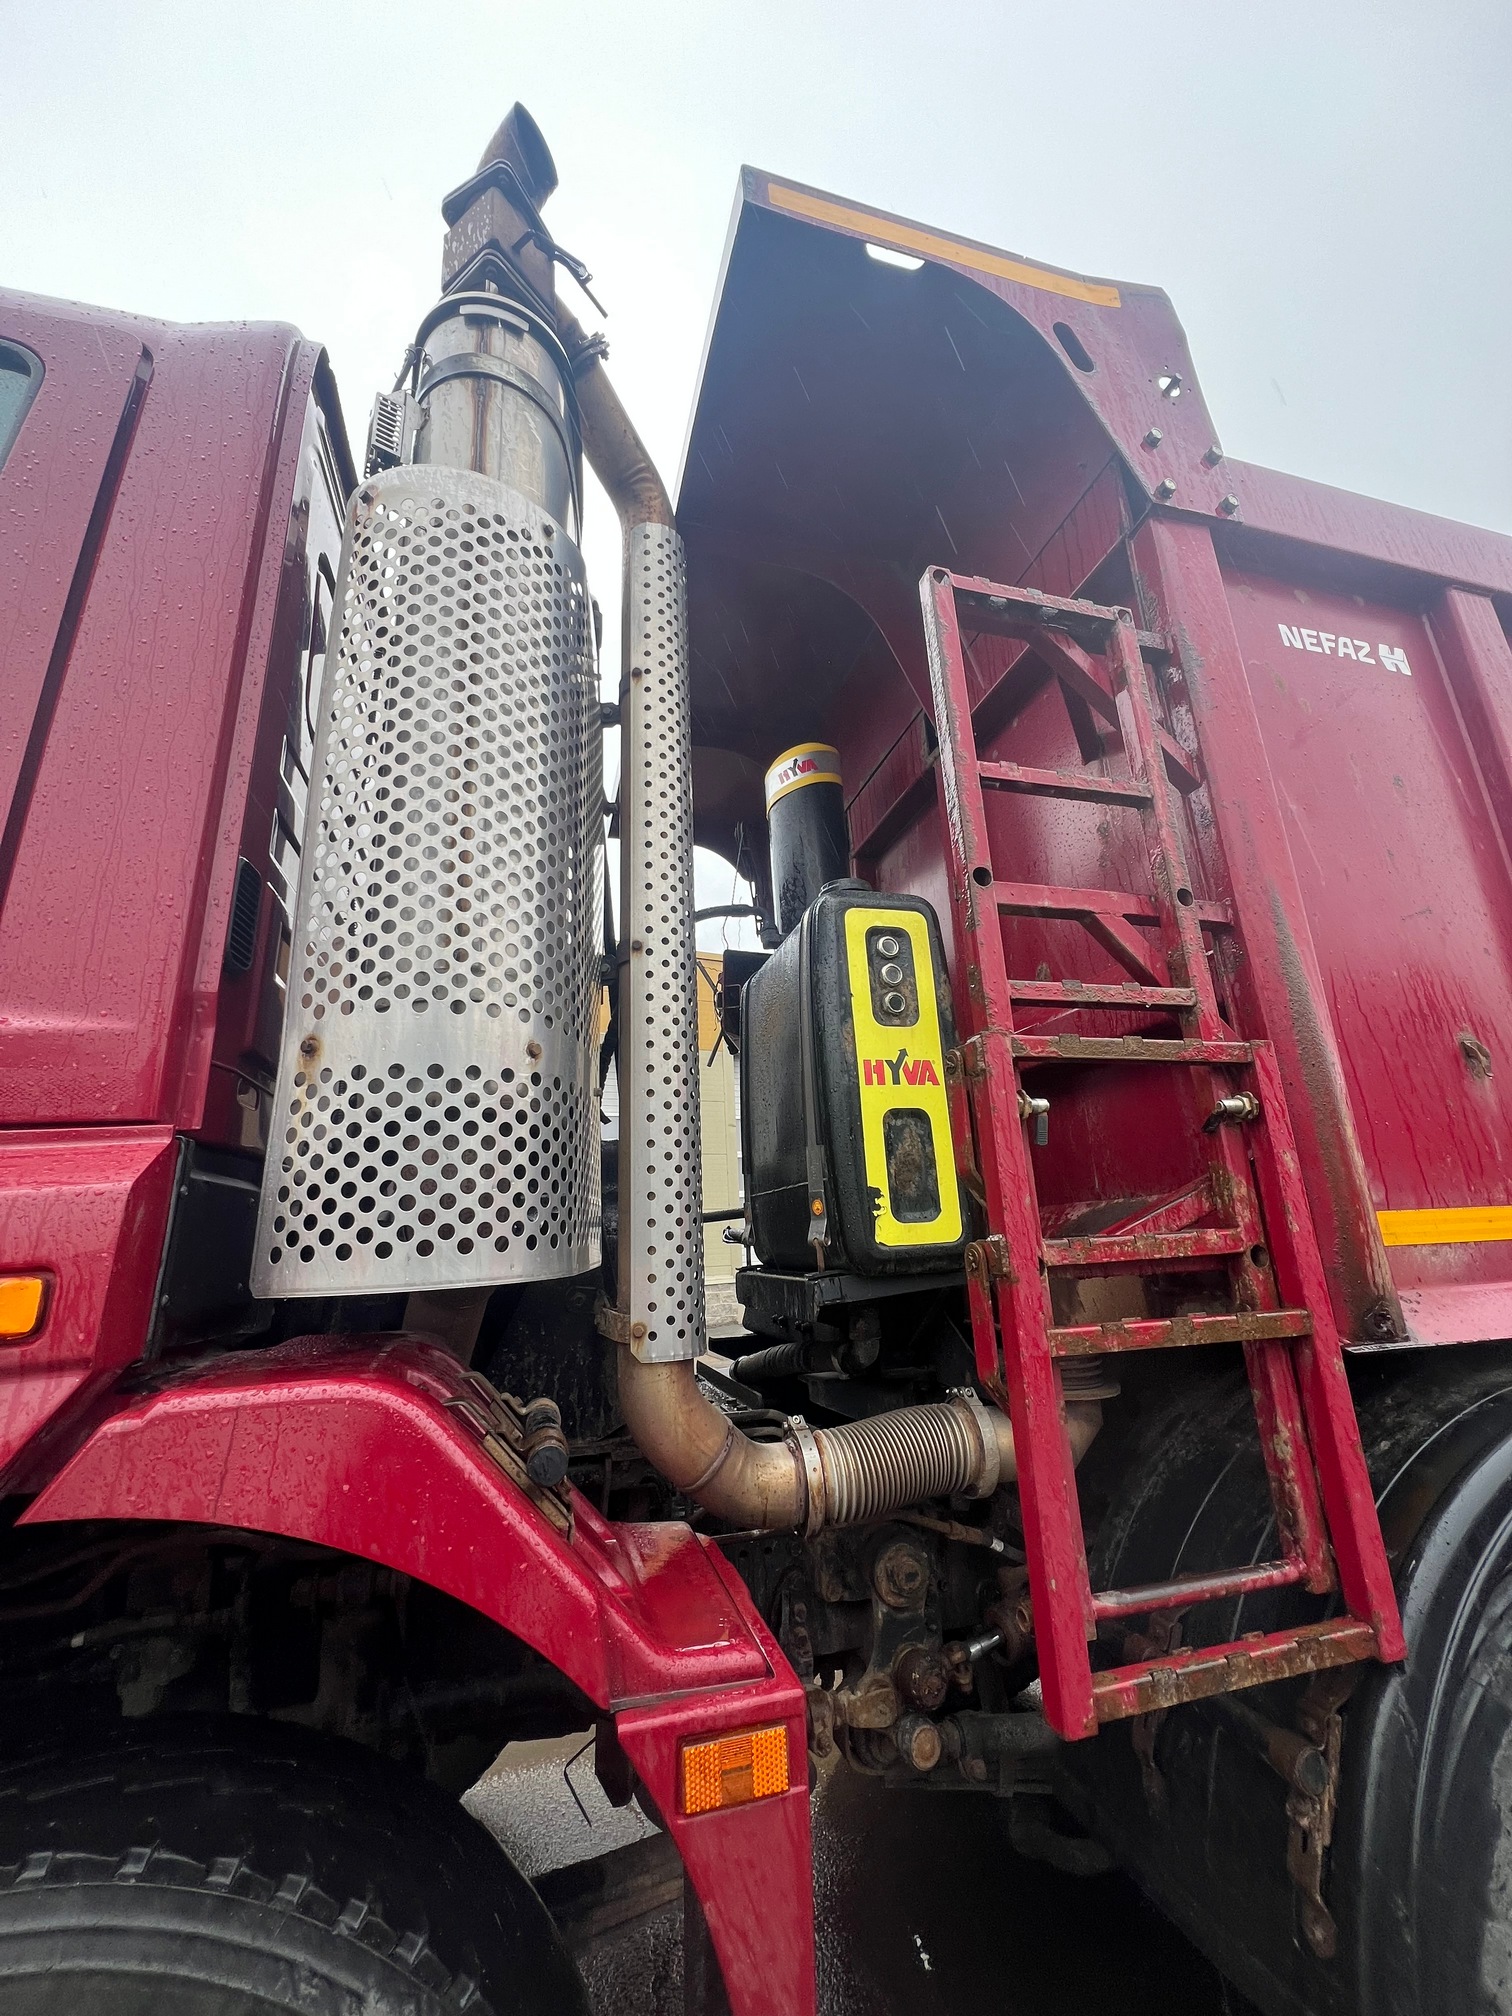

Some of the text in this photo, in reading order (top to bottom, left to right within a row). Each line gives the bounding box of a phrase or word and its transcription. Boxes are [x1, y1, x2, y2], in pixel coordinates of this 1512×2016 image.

[1278, 623, 1376, 665] NEFAZ
[777, 758, 819, 785] HYVA
[863, 1048, 940, 1086] HYVA
